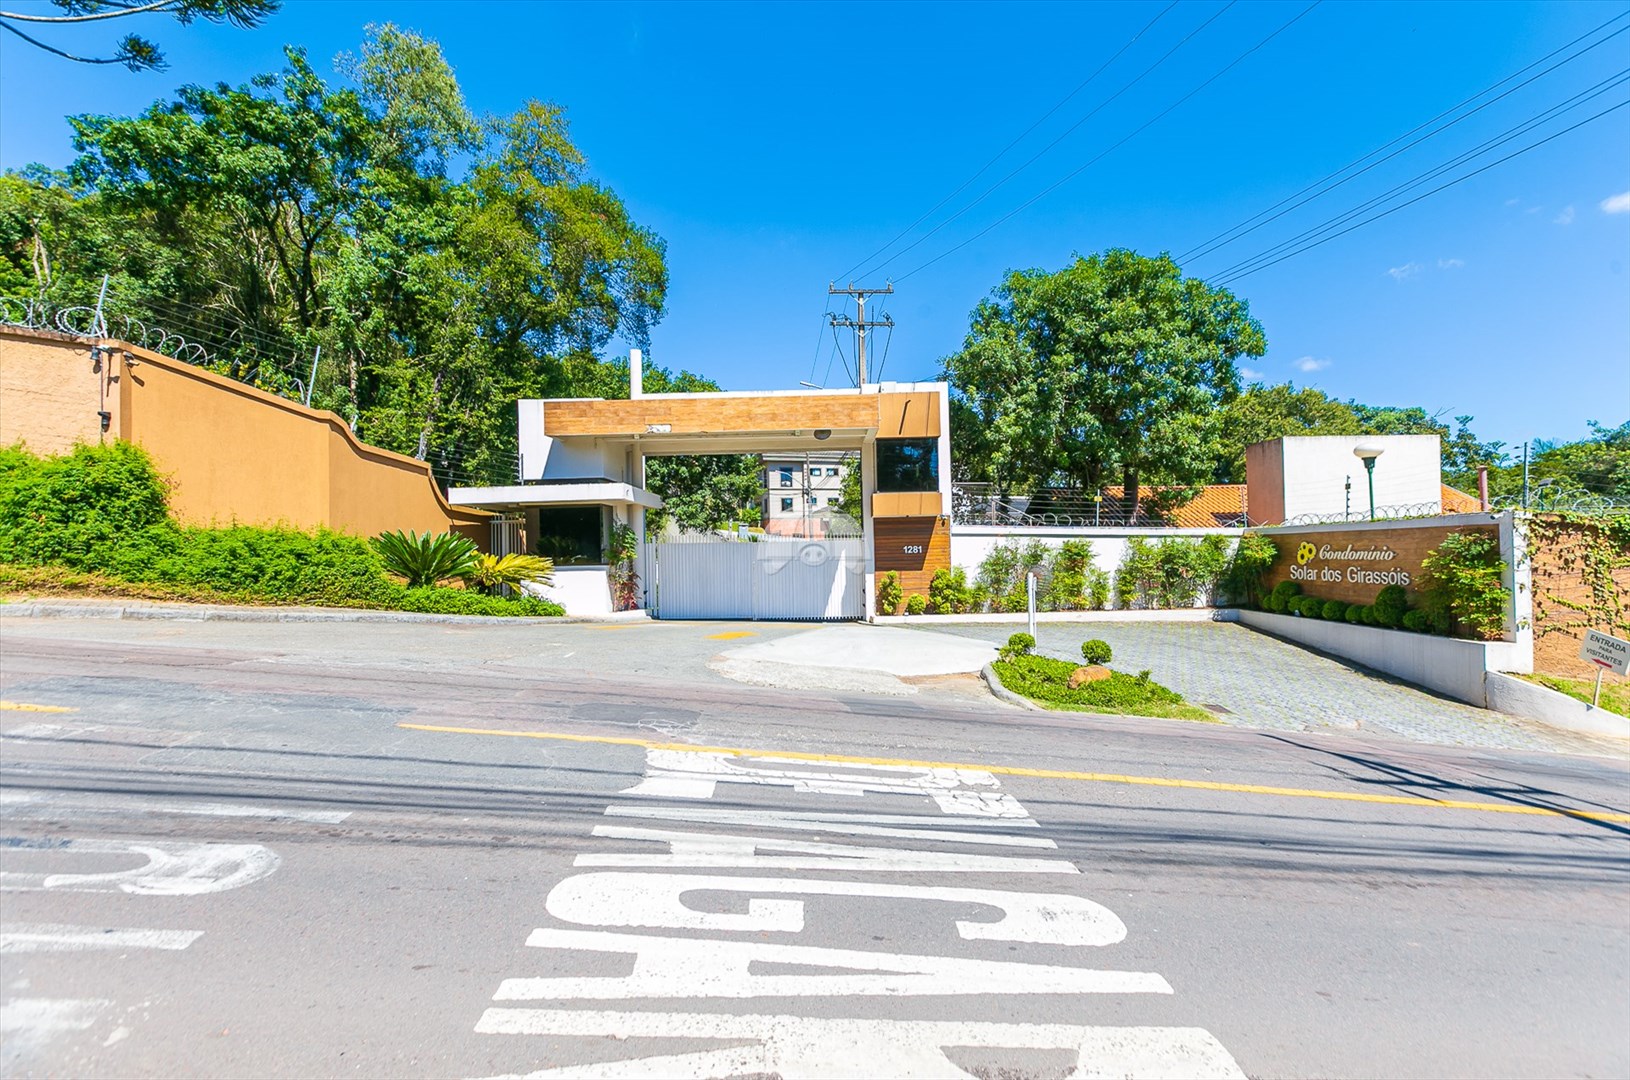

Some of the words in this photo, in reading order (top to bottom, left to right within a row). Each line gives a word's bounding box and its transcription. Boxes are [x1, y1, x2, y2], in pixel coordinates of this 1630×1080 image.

[903, 545, 922, 554] 1281
[1319, 544, 1398, 561] Condomínio
[1290, 565, 1318, 580] Solar
[1321, 566, 1342, 582] dos
[1347, 566, 1411, 586] Girassóis
[1590, 634, 1627, 653] ENTRADA
[1599, 645, 1613, 655] PARA
[1586, 647, 1623, 666] VISITANTES
